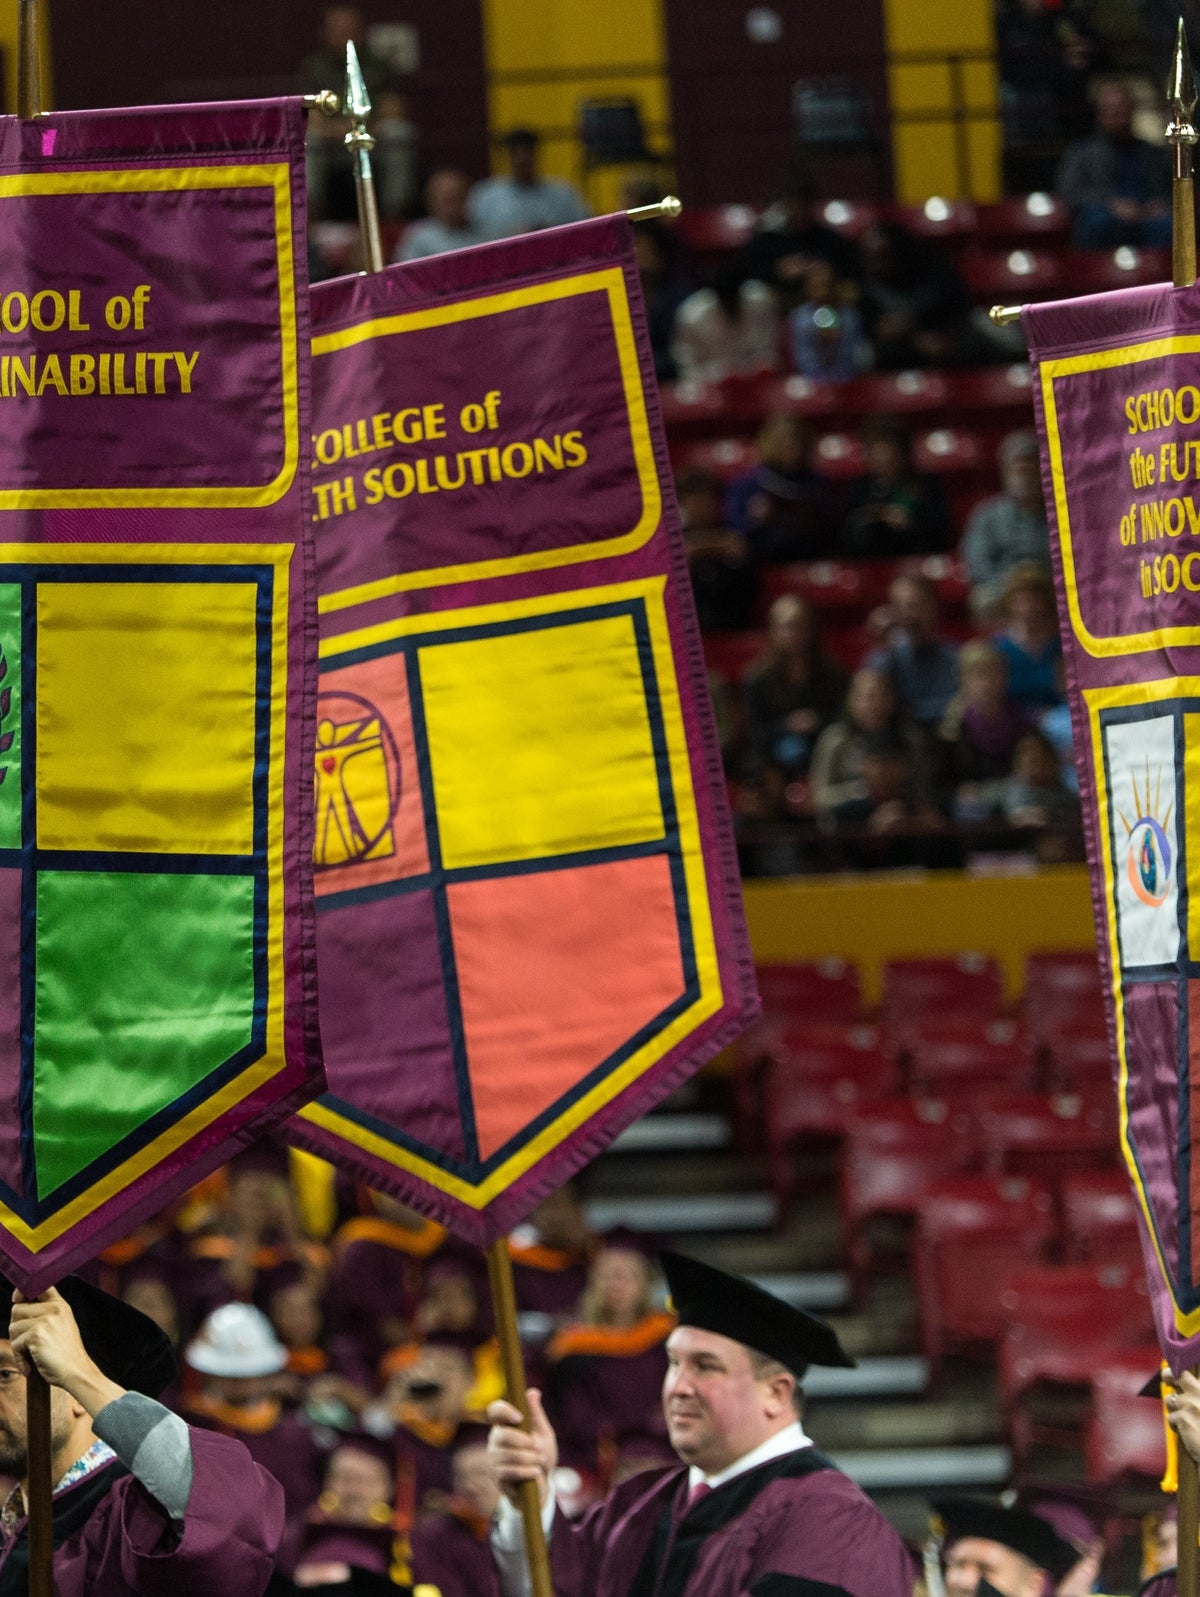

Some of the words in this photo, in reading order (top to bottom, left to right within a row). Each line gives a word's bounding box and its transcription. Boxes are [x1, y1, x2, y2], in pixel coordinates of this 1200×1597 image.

[104, 284, 152, 331] of
[459, 390, 502, 434] of
[1125, 385, 1200, 435] SCHOO
[312, 475, 358, 522] TH
[363, 430, 588, 505] SOLUTIONS
[1129, 447, 1156, 489] the
[1119, 503, 1137, 546] of
[1140, 496, 1200, 543] INNOV
